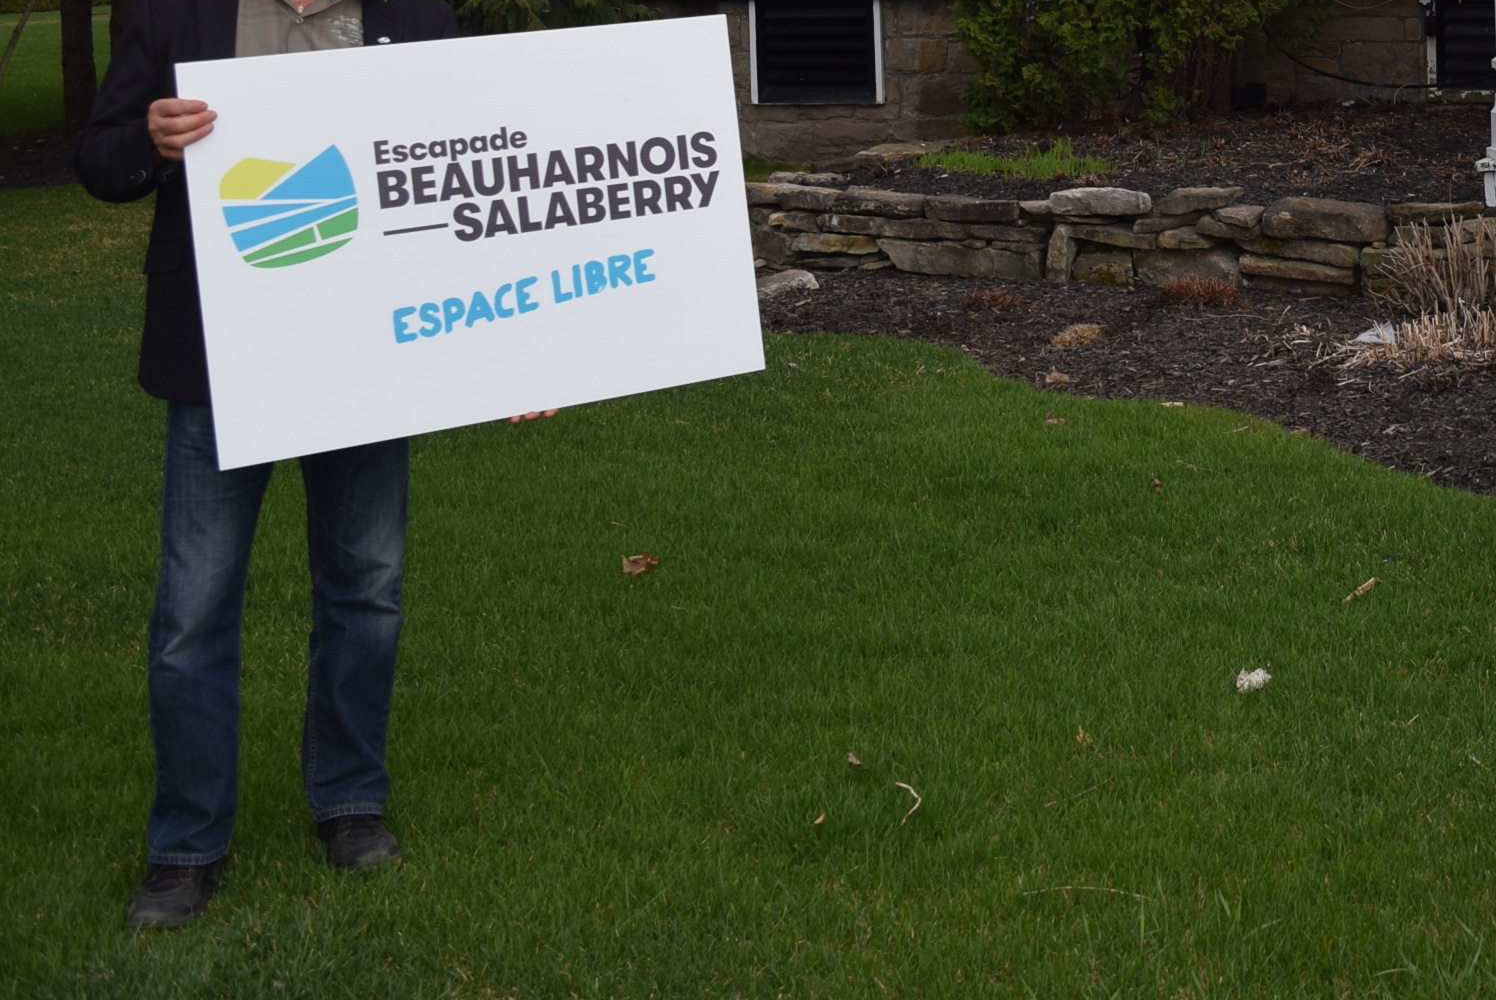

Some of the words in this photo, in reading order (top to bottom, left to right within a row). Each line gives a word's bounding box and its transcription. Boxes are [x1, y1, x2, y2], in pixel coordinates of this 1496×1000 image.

[374, 127, 528, 165] Escapade
[376, 131, 718, 209] BEAUHARNOIS
[453, 170, 720, 242] SALABERRY
[393, 277, 540, 344] ESPACE
[551, 248, 657, 304] LIBRE
